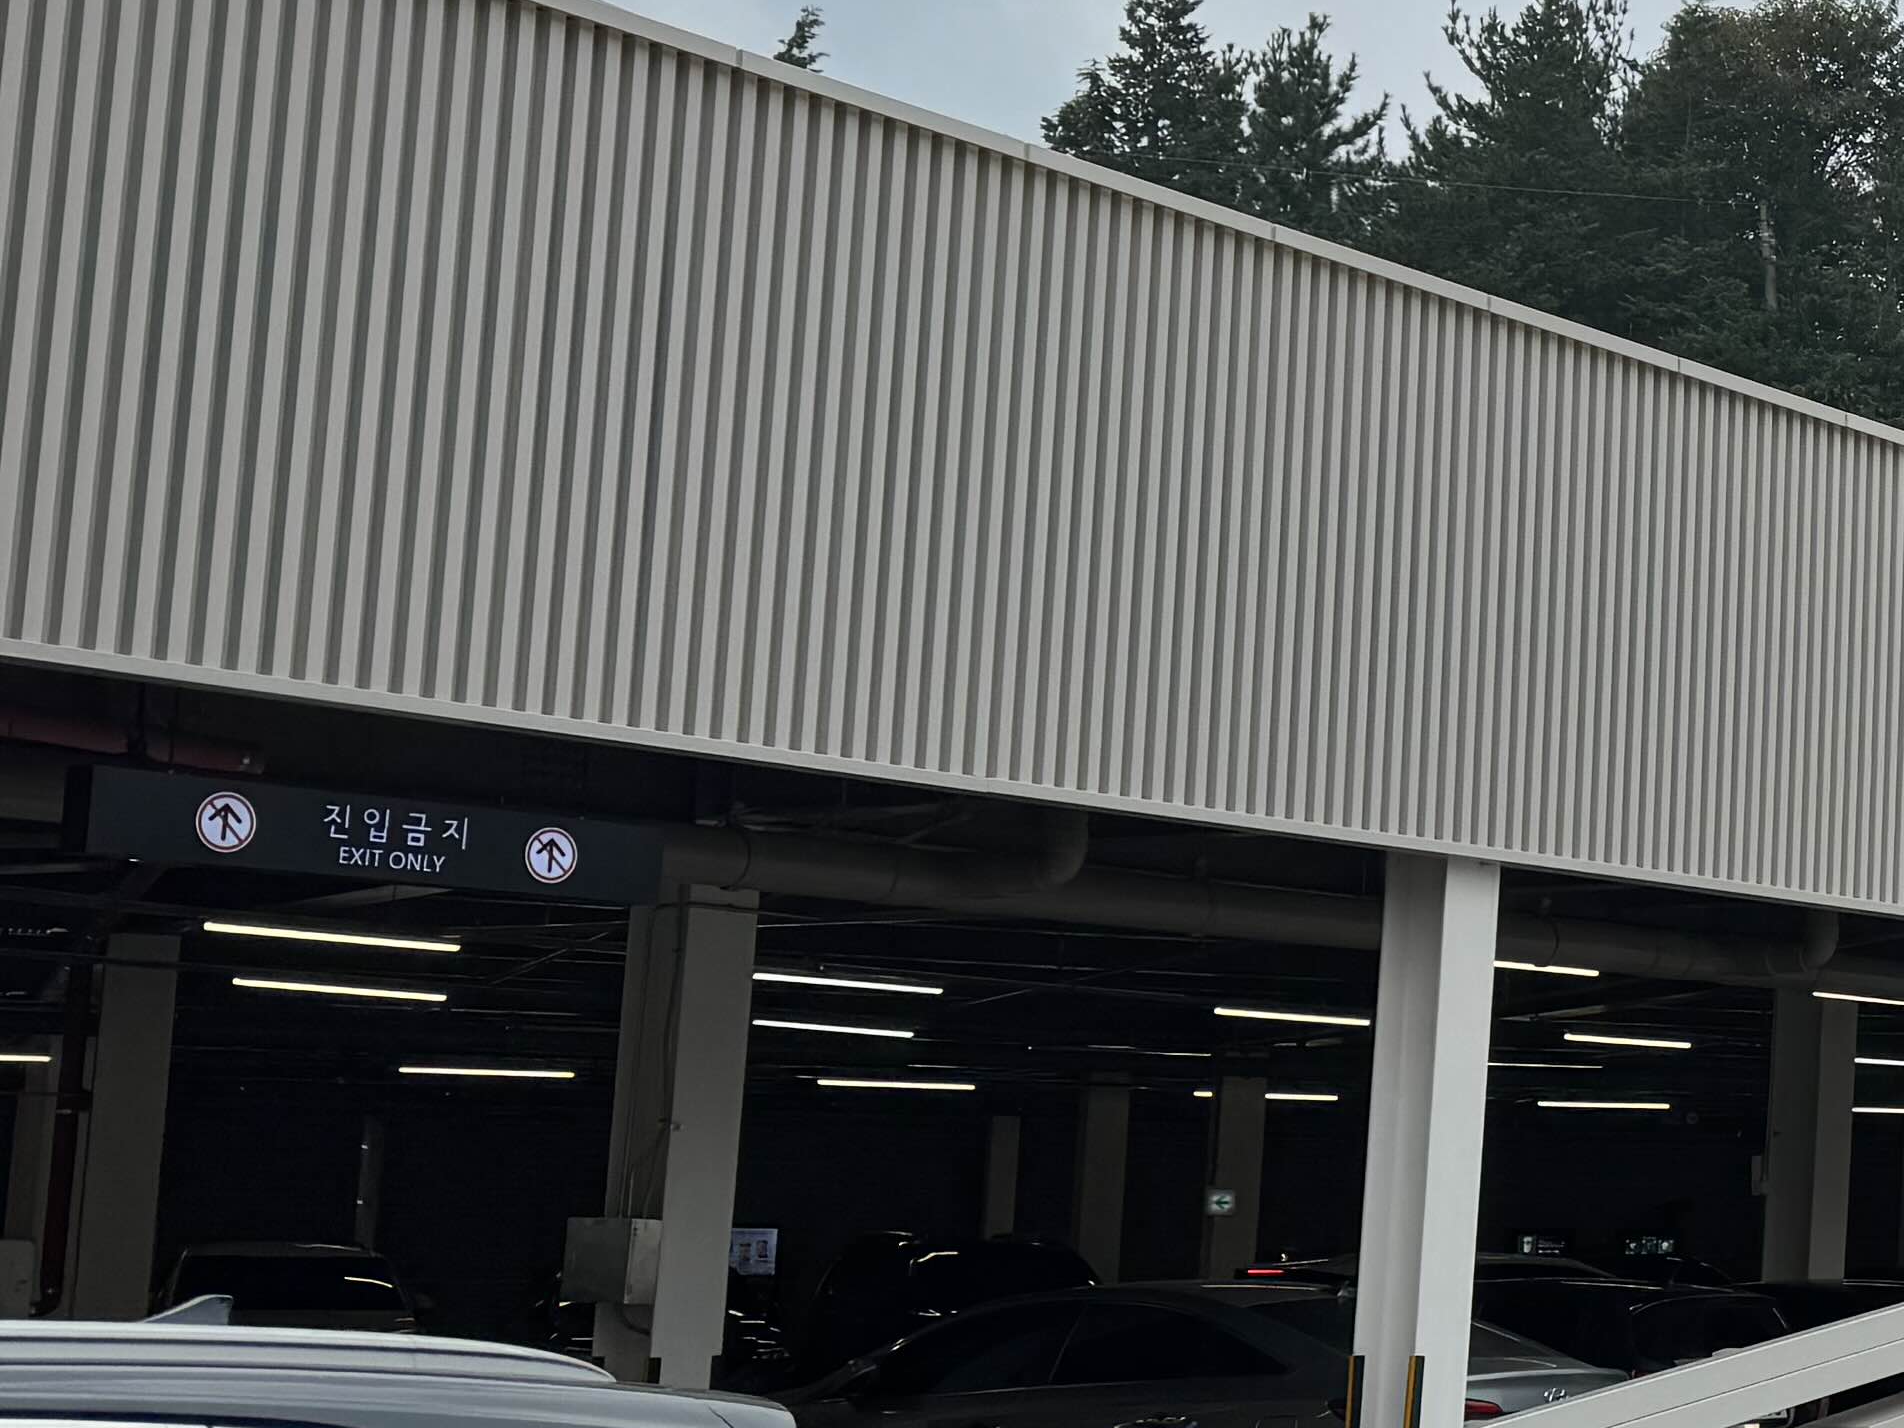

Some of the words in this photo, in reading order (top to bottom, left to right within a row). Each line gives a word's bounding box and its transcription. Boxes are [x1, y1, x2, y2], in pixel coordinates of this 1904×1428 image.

[323, 804, 469, 851] 진입금지
[338, 846, 384, 868] EXIT
[389, 851, 446, 873] ONLY
